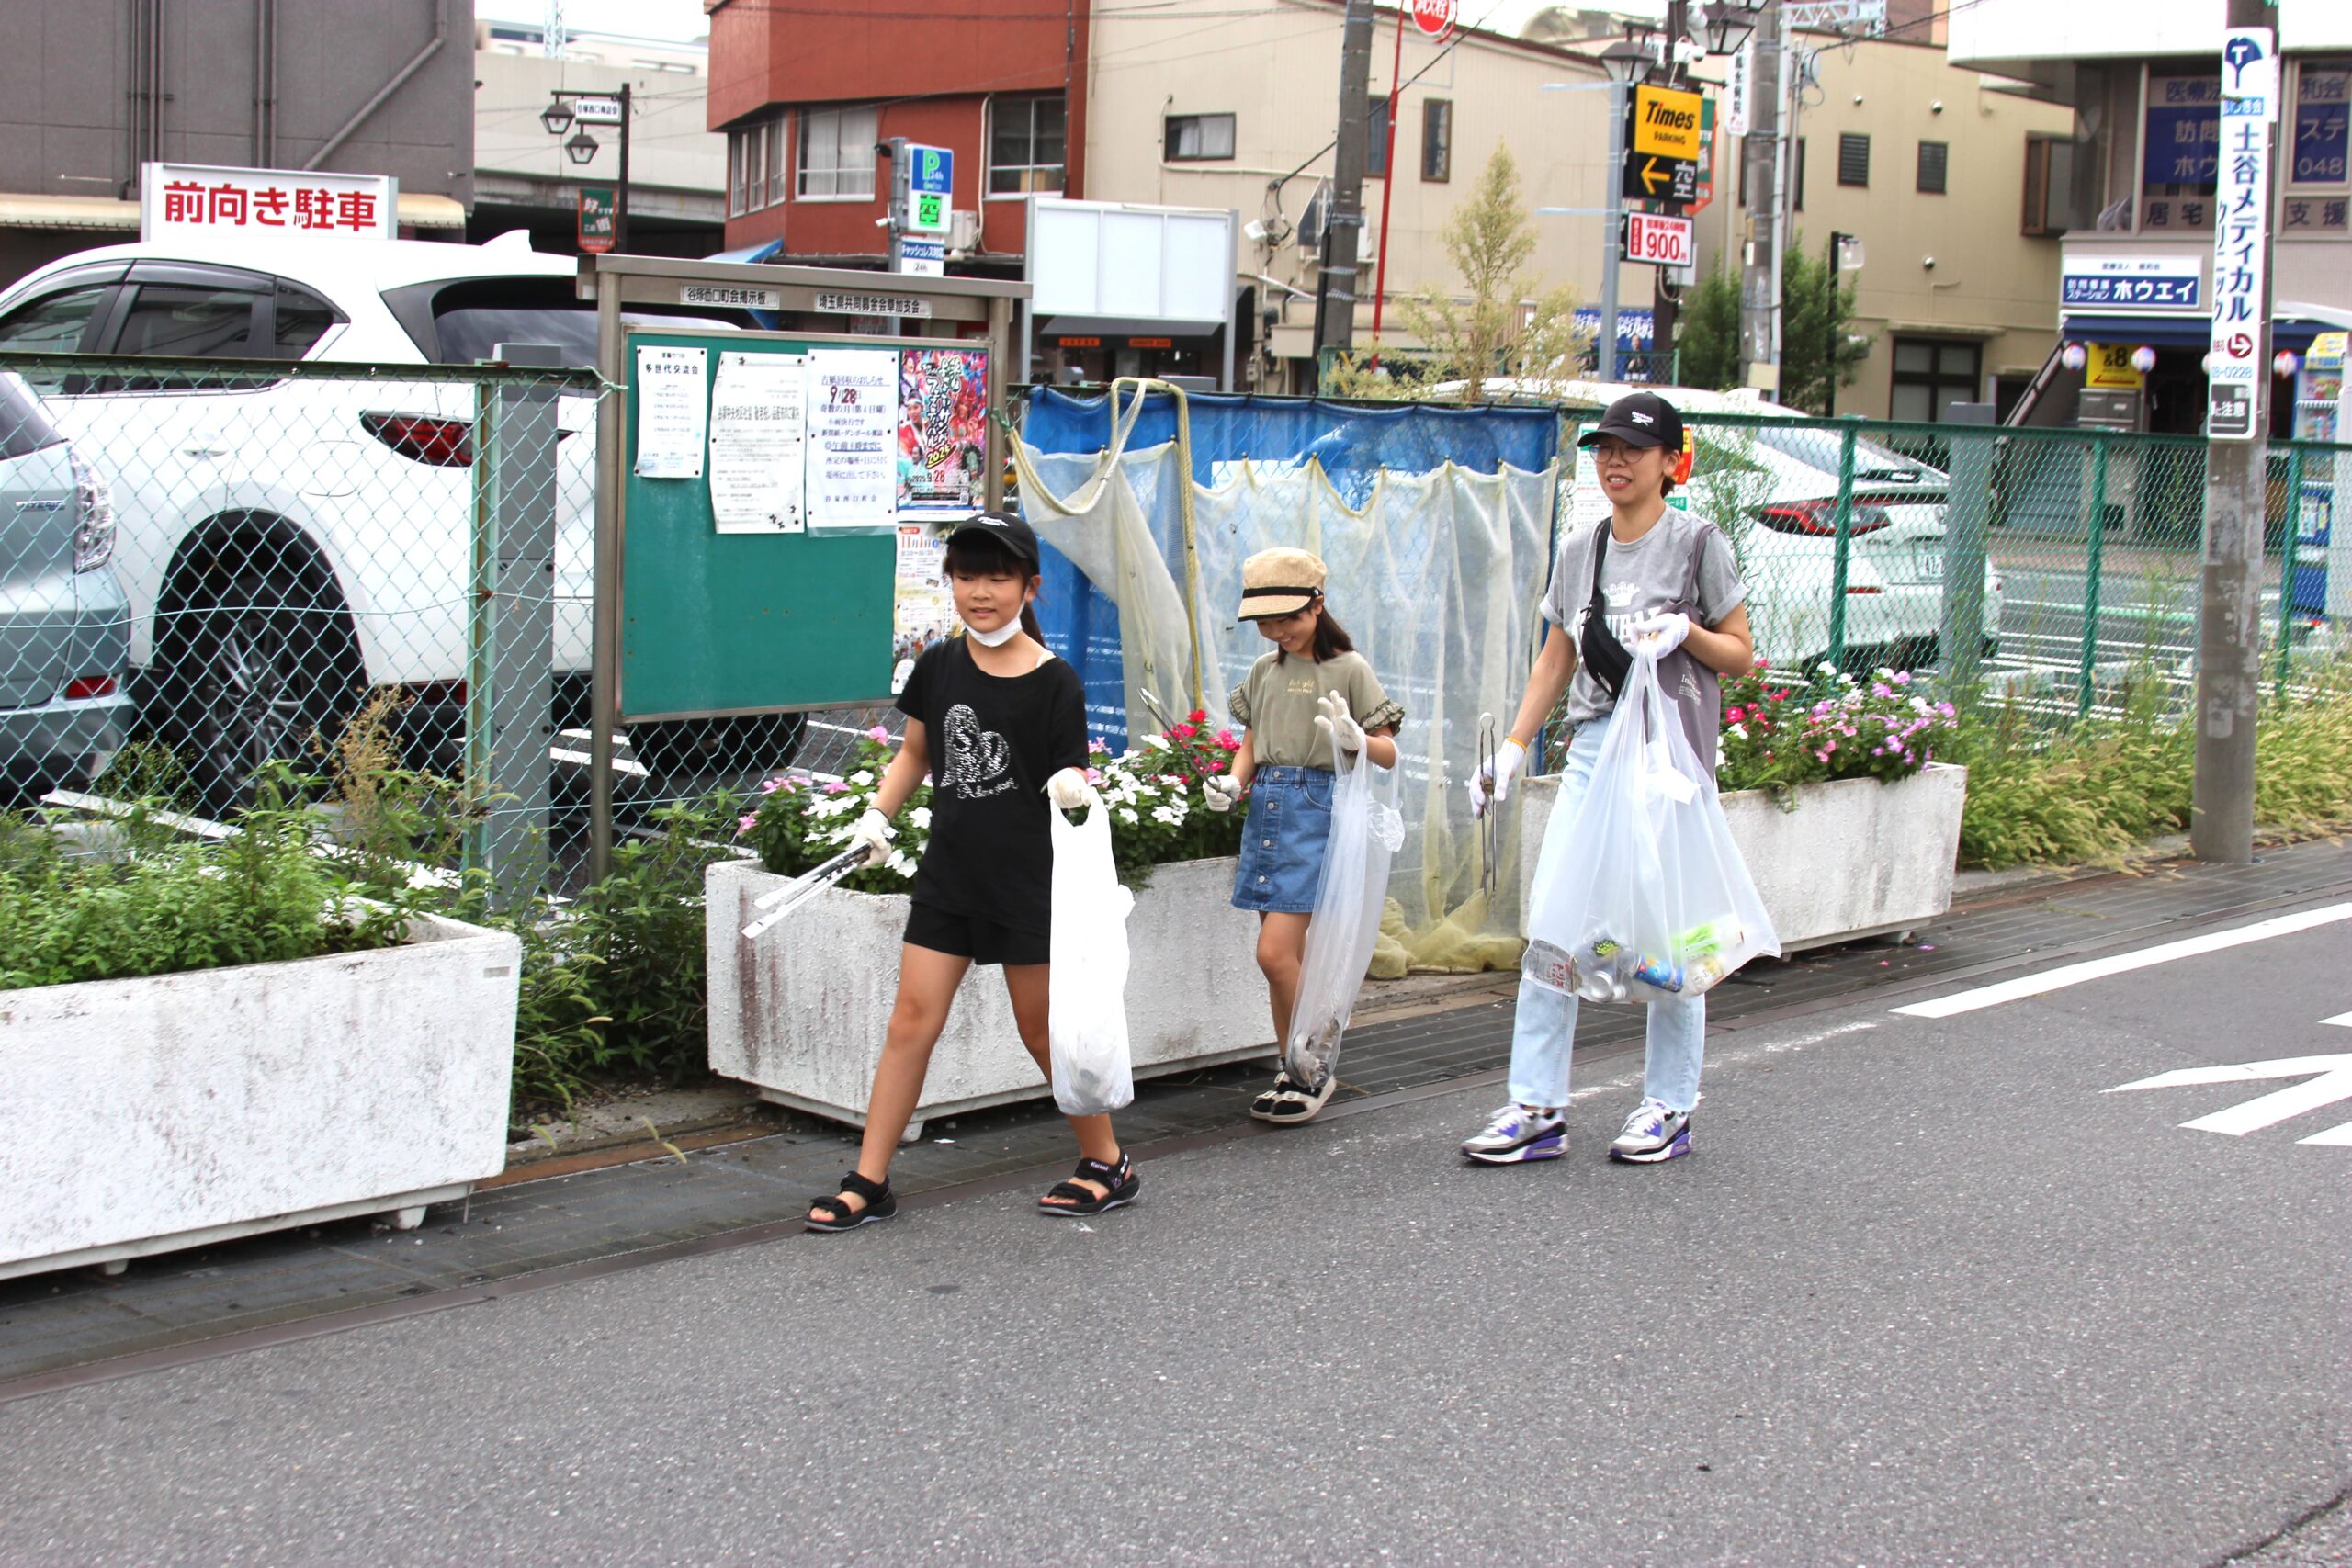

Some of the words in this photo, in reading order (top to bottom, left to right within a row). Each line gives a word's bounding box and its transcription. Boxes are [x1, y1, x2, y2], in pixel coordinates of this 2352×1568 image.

[1645, 100, 1695, 130] Times
[1653, 131, 1687, 145] PARKING
[2301, 118, 2346, 141] ステ
[922, 150, 941, 180] P
[2299, 157, 2343, 176] 048
[1673, 160, 1696, 198] 空
[164, 180, 377, 231] 前向き駐車
[919, 193, 942, 228] 空
[2147, 202, 2203, 226] 居宅
[2289, 201, 2346, 226] 支援
[2227, 122, 2261, 322] 土谷メディカル
[687, 287, 766, 305] 谷塚西口町会掲示板
[2067, 289, 2109, 301] ステーション
[2113, 278, 2195, 302] ホウエイ
[819, 293, 920, 315] 埼玉県共同募金会草加支会
[926, 446, 952, 466] 2025
